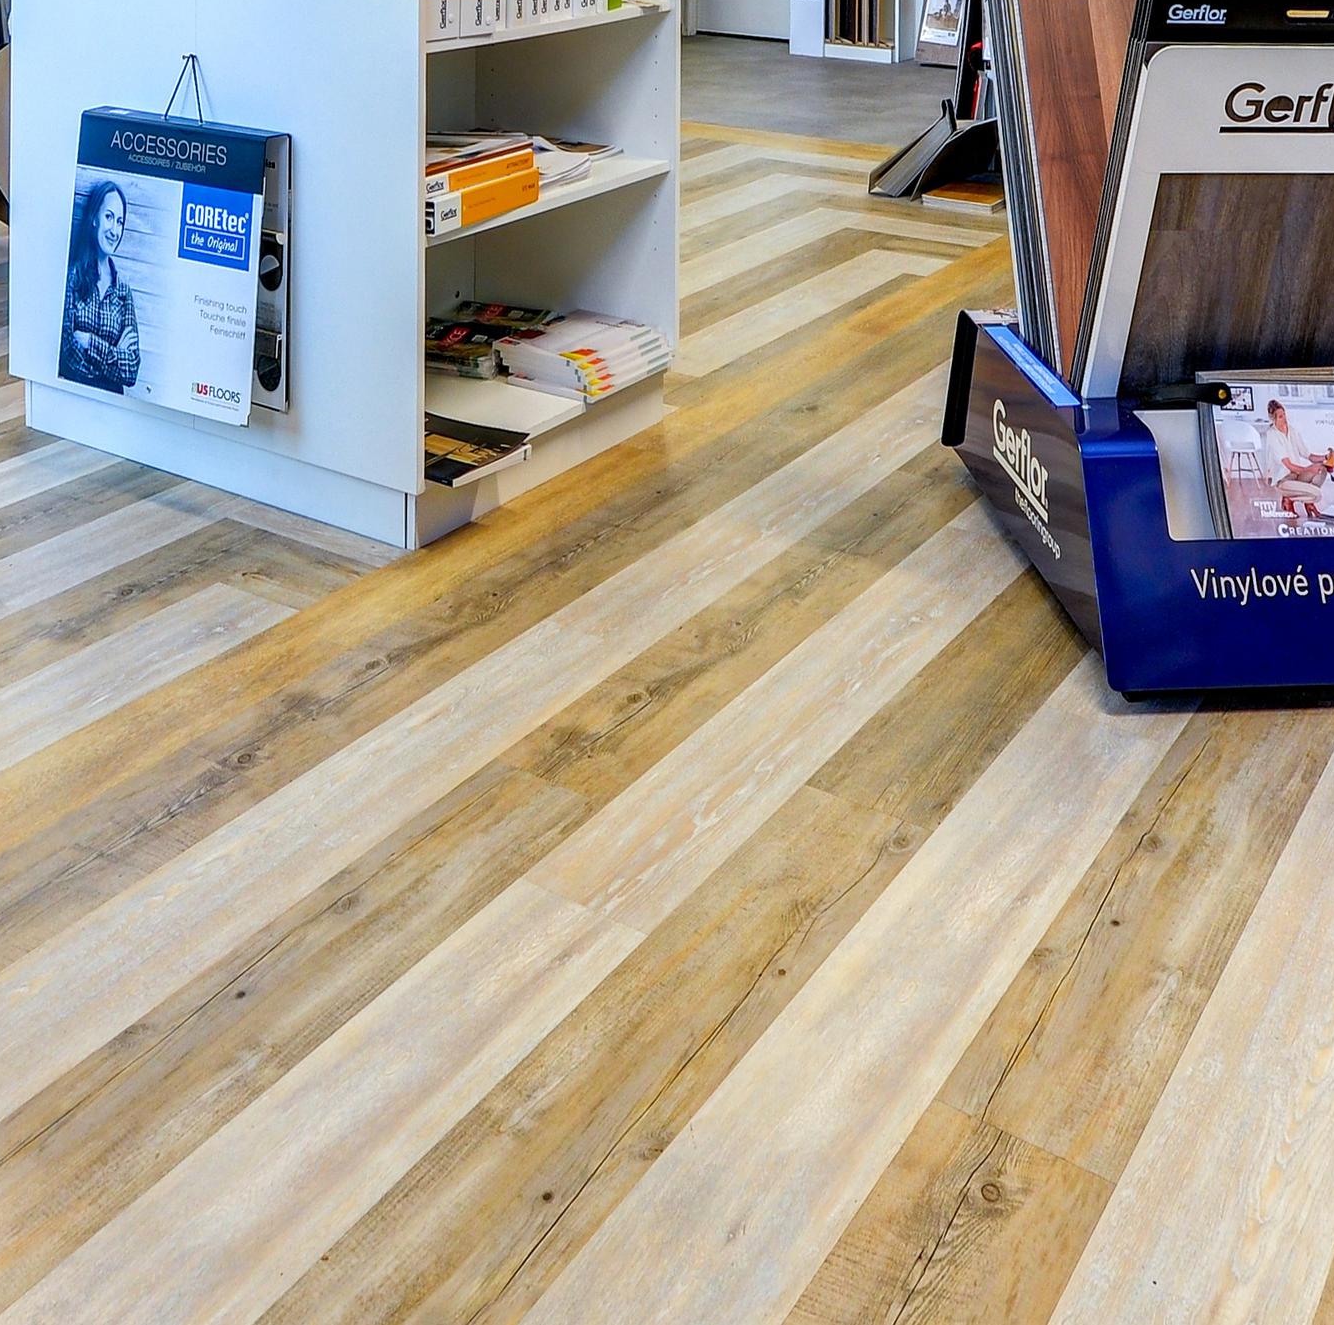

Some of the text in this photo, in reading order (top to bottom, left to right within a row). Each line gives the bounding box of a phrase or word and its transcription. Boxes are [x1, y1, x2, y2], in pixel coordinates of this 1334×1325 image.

[1167, 4, 1227, 21] Gerflor
[110, 130, 228, 166] ACCESSORIES
[185, 203, 248, 234] COREtec
[190, 232, 238, 253] the Original
[194, 294, 247, 315] Finishing touch
[200, 309, 246, 327] Touche finale
[992, 398, 1049, 510] Gerflor
[1190, 565, 1310, 606] Vinylové
